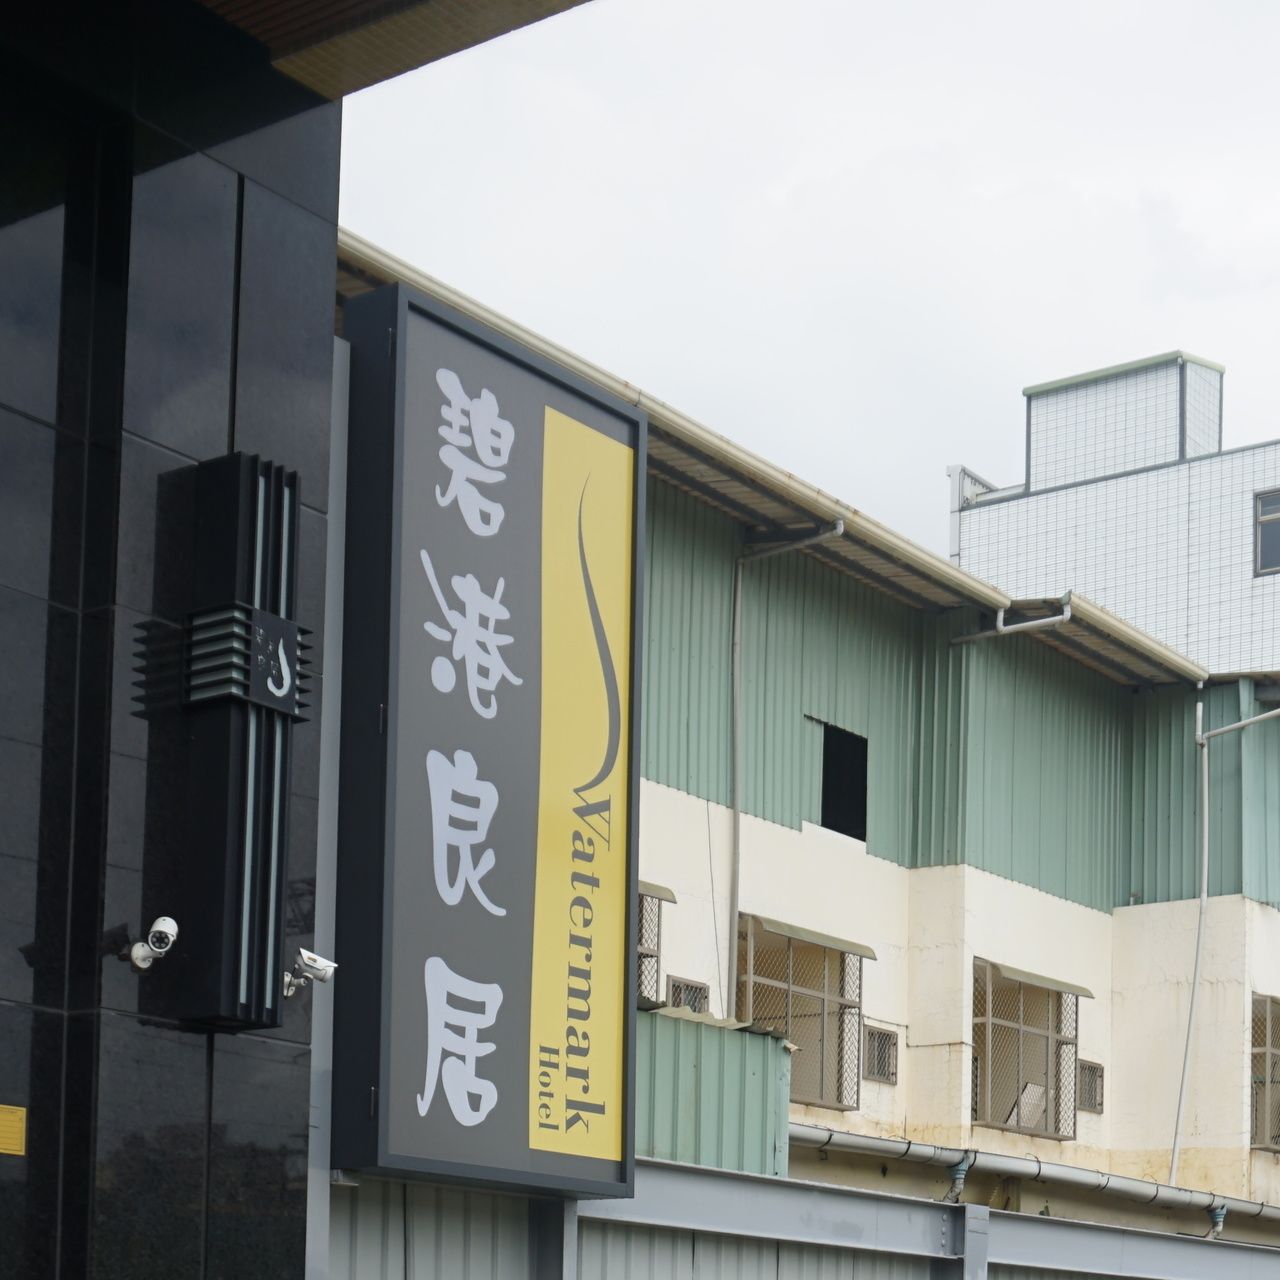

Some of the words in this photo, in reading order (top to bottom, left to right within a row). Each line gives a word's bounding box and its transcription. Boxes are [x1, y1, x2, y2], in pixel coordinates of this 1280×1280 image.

[417, 368, 523, 1127] 碧港良居
[538, 1044, 560, 1131] Hotel
[565, 786, 611, 1134] Watermark
